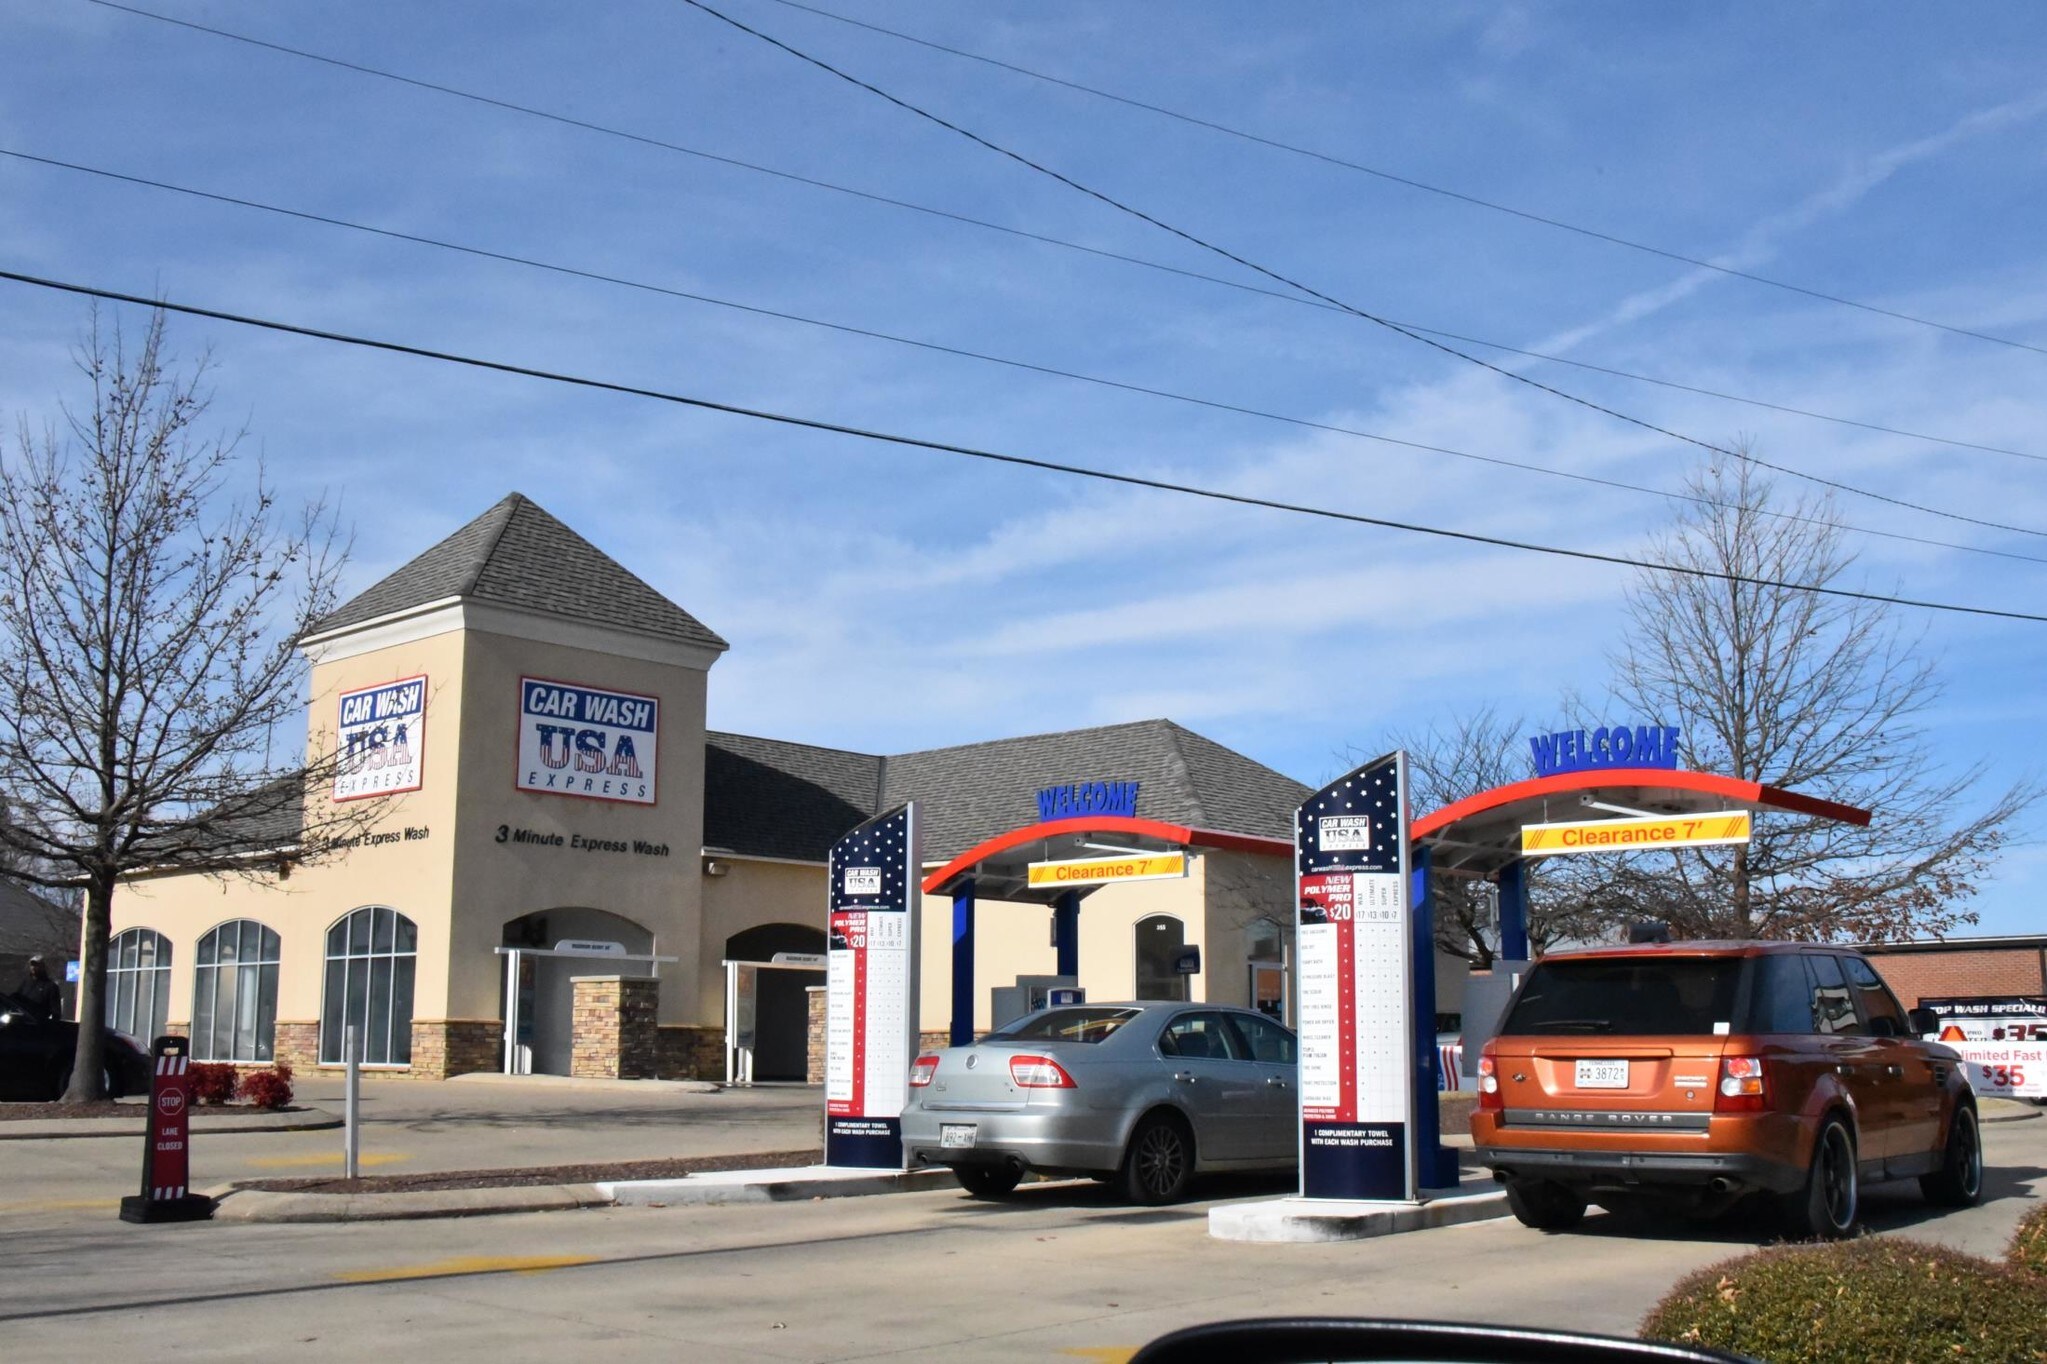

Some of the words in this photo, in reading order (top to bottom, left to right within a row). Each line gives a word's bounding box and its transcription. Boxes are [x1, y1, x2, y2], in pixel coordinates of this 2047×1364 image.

[343, 694, 373, 725] CAR
[375, 684, 420, 718] WASH
[528, 686, 577, 717] CAR
[584, 695, 650, 728] WASH
[346, 723, 412, 775] USA
[536, 723, 643, 778] USA
[1530, 726, 1680, 775] WELCOME
[340, 770, 414, 793] EXPRESS
[528, 771, 647, 798] EXPRESS
[1036, 780, 1140, 819] WELCOME
[1321, 819, 1338, 829] CAR
[1340, 817, 1366, 828] WASH
[364, 831, 401, 847] Express
[404, 825, 430, 840] Wash
[495, 824, 509, 843] 3
[513, 828, 564, 846] Minute
[570, 834, 628, 852] Express
[633, 840, 670, 857] Wash
[1324, 828, 1364, 843] USA
[1562, 826, 1676, 847] Clearance
[1682, 821, 1703, 840] 7'
[1056, 862, 1134, 881] Clearance
[1139, 860, 1152, 875] 7'
[848, 877, 877, 888] USA
[1325, 875, 1352, 885] NEW
[1304, 884, 1351, 895] POLYMER
[1328, 893, 1352, 902] PRO
[1329, 903, 1352, 920] $20
[850, 934, 866, 948] $20
[1954, 1004, 1989, 1013] WASH
[2013, 1050, 2042, 1061] Fast
[1595, 1067, 1619, 1080] 3872
[1982, 1064, 2025, 1087] $35
[162, 1097, 181, 1107] STOP
[1535, 1113, 1594, 1121] RANGE
[1608, 1114, 1672, 1122] ROVER
[162, 1127, 178, 1136] LANE
[1318, 1129, 1367, 1137] COMPLIMENTARY
[157, 1141, 183, 1151] CLOSED
